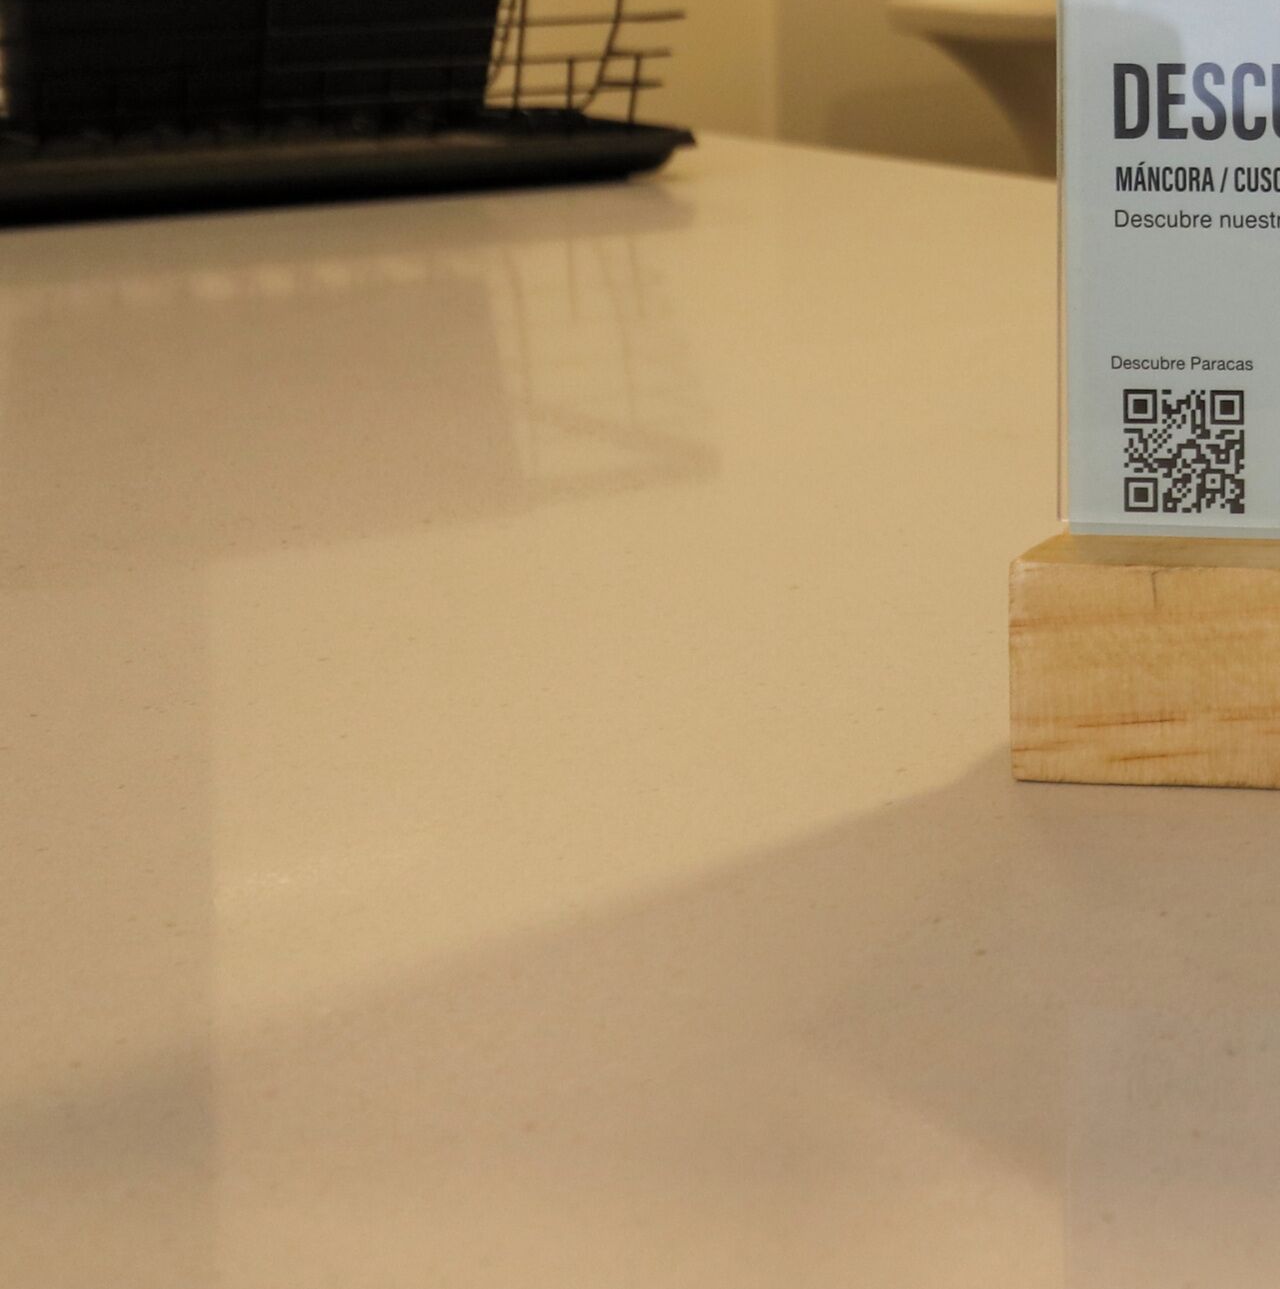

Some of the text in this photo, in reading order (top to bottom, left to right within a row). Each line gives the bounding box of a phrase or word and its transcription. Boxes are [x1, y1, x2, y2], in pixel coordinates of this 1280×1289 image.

[1115, 162, 1215, 192] MÁNCORA
[1114, 210, 1212, 229] Descubre
[1111, 355, 1254, 371] Descubre Paracas
